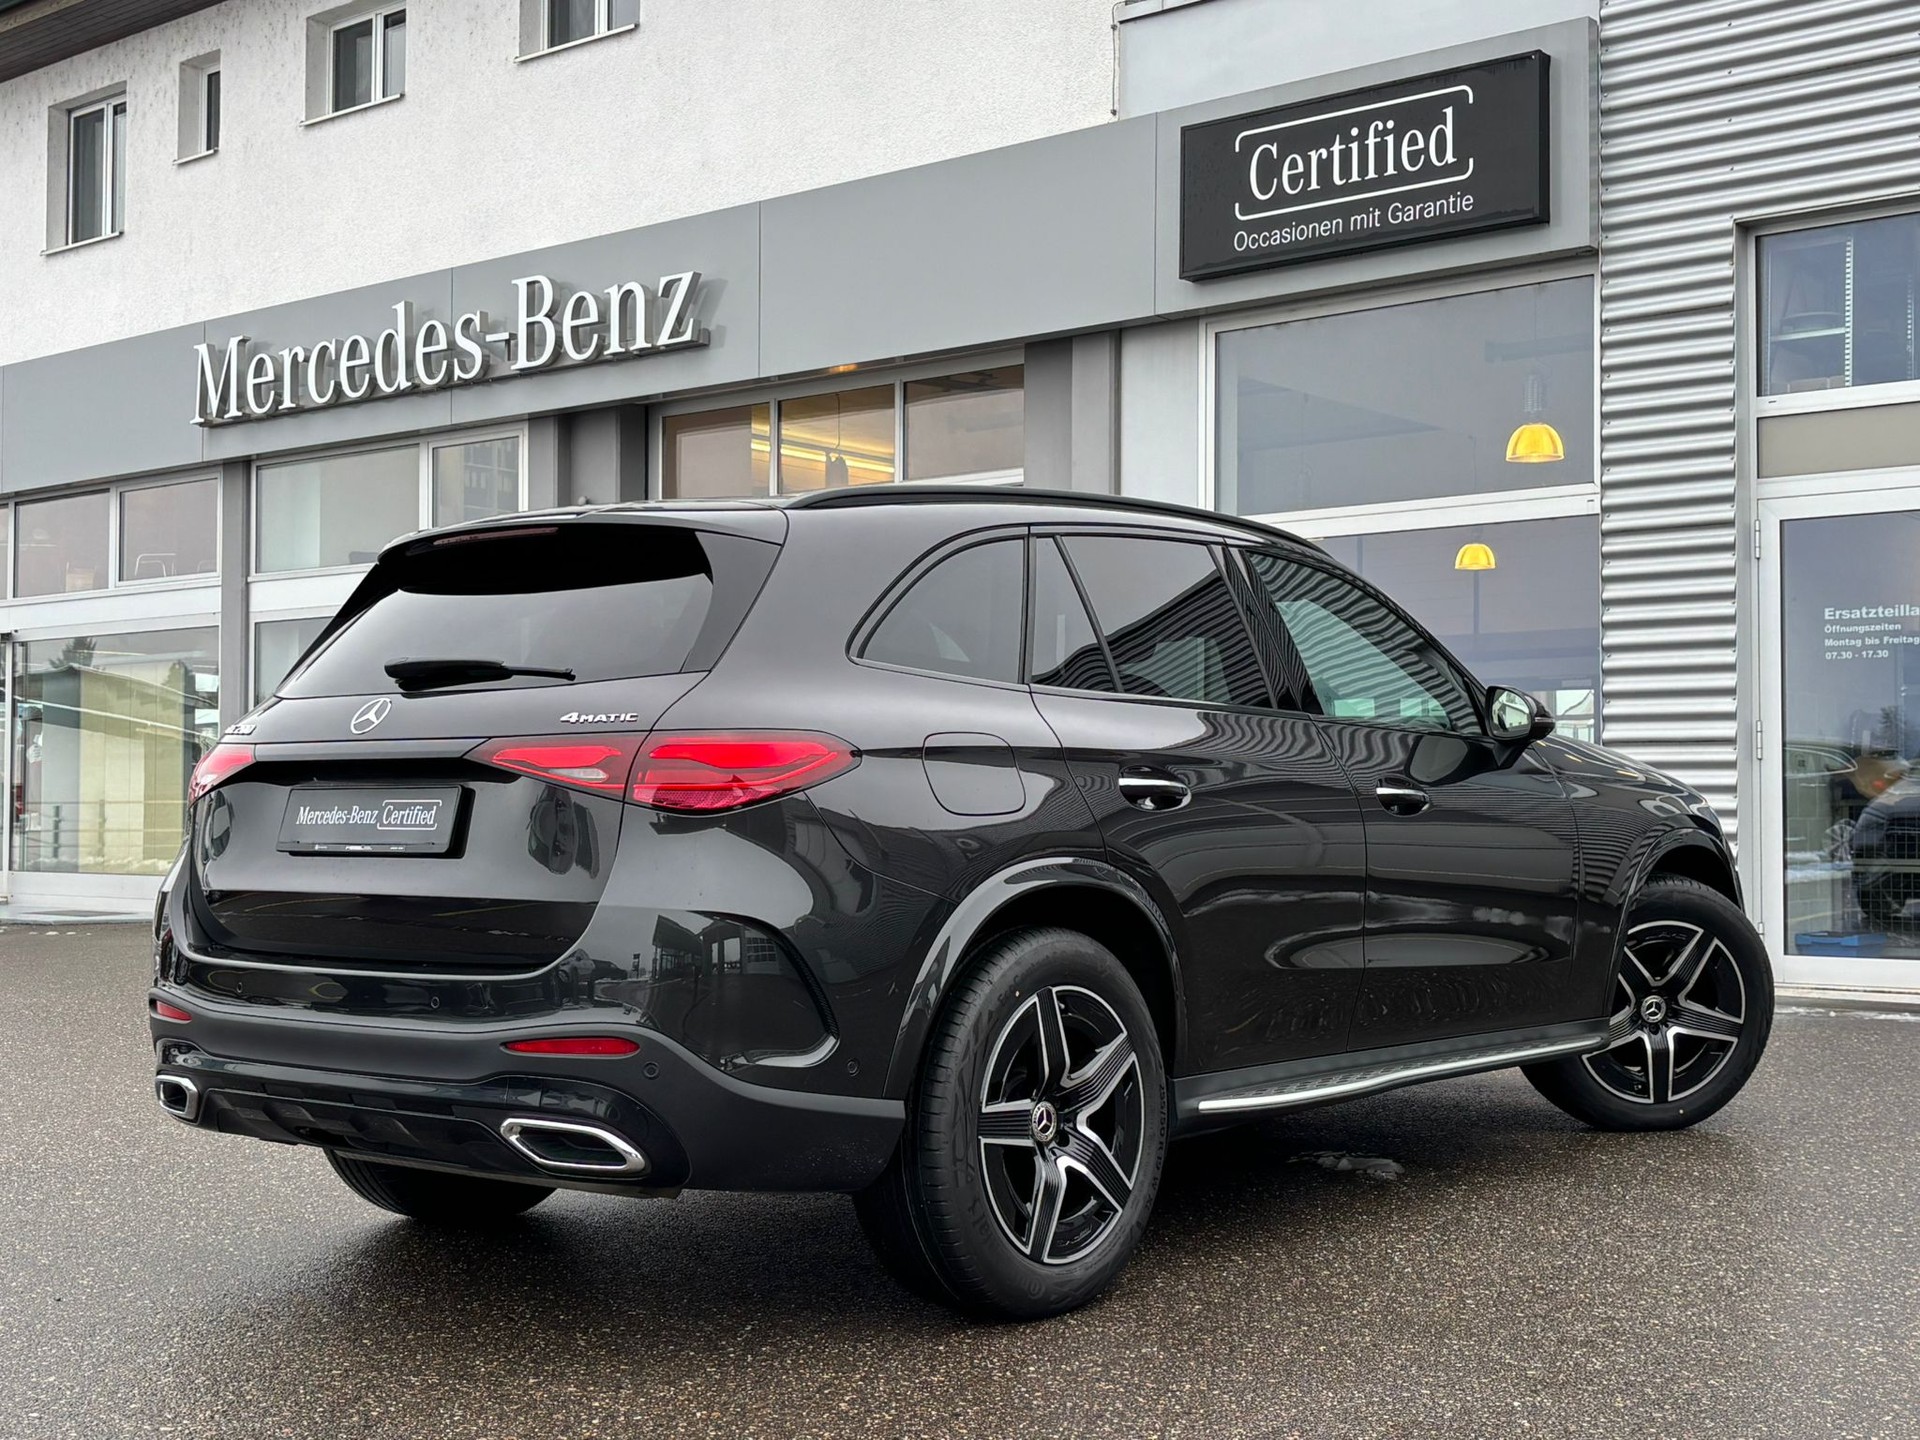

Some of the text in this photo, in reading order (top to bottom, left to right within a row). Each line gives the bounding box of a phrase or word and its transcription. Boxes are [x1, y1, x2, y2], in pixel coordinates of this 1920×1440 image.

[1249, 105, 1457, 201] Certified
[1234, 190, 1474, 252] Occasionen mit Garantie
[190, 270, 702, 425] Mercedes-Benz
[1824, 604, 1920, 620] Ersatzteilla
[1824, 623, 1901, 633] Öffnungszeiten
[1824, 635, 1920, 648] Montag bis Freitag
[1825, 651, 1853, 660] 07.30
[1862, 649, 1889, 659] 17.30
[560, 711, 639, 724] 4MATIC
[296, 805, 437, 825] Mercedes-Benz Certified
